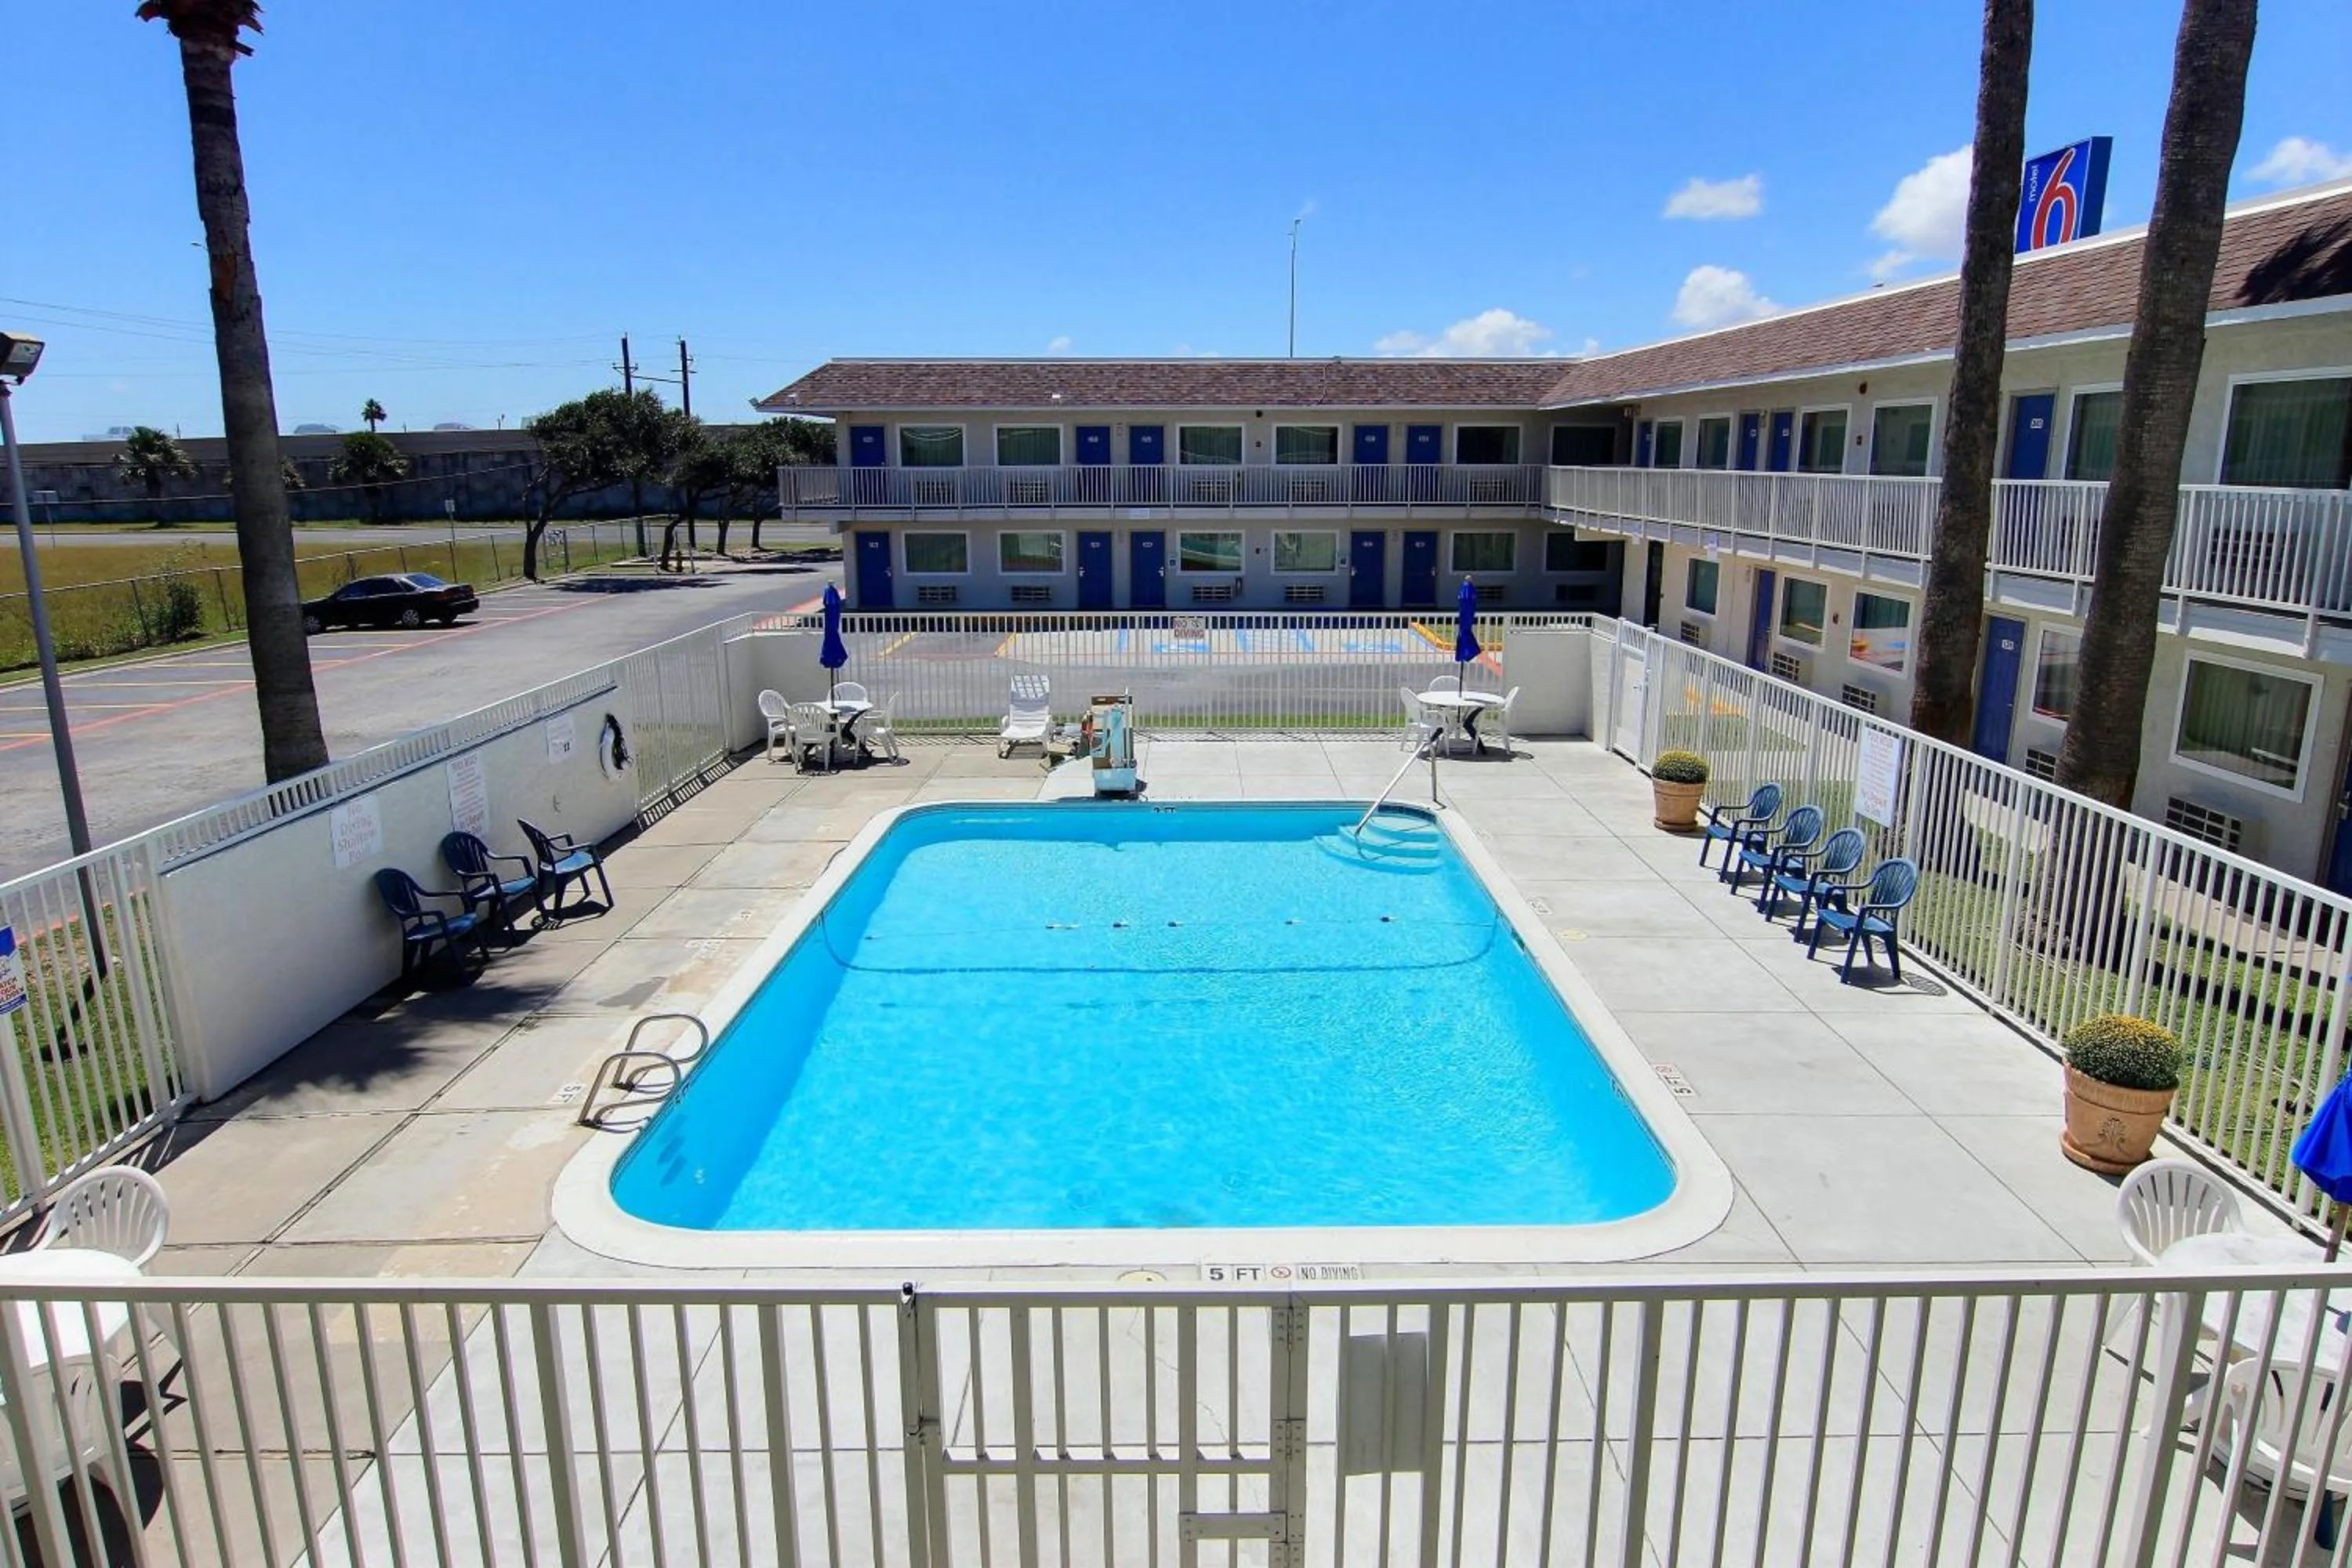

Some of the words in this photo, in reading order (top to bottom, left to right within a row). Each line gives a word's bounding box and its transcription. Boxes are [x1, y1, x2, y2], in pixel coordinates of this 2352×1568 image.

[2031, 147, 2077, 251] 6
[1174, 629, 1205, 639] DIVING
[1209, 1268, 1224, 1280] 5
[1236, 1268, 1261, 1280] FT
[1301, 1266, 1316, 1280] NO
[1321, 1266, 1359, 1280] DIVING
